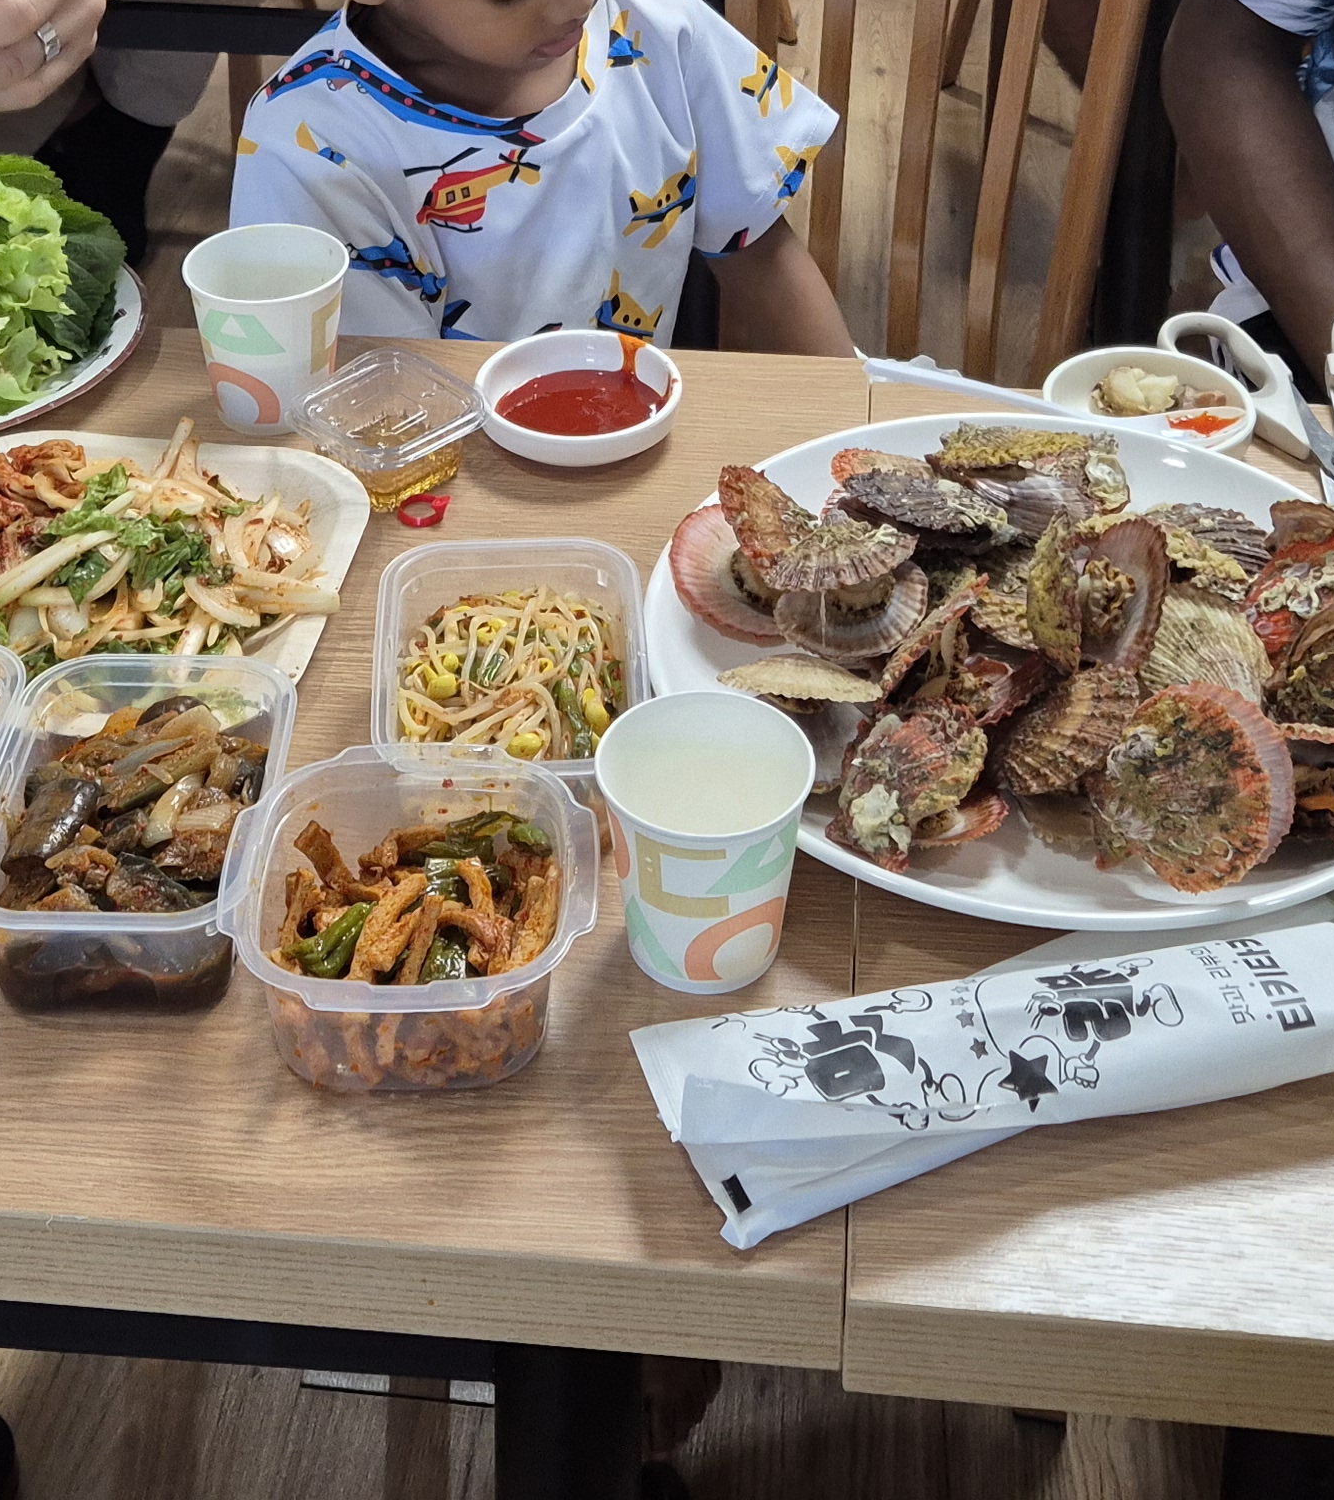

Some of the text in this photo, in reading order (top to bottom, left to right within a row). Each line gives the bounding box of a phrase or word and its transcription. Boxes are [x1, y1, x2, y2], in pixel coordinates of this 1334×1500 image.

[1186, 944, 1257, 1026] 맛과 리뷰의
[802, 1012, 917, 1101] 맛
